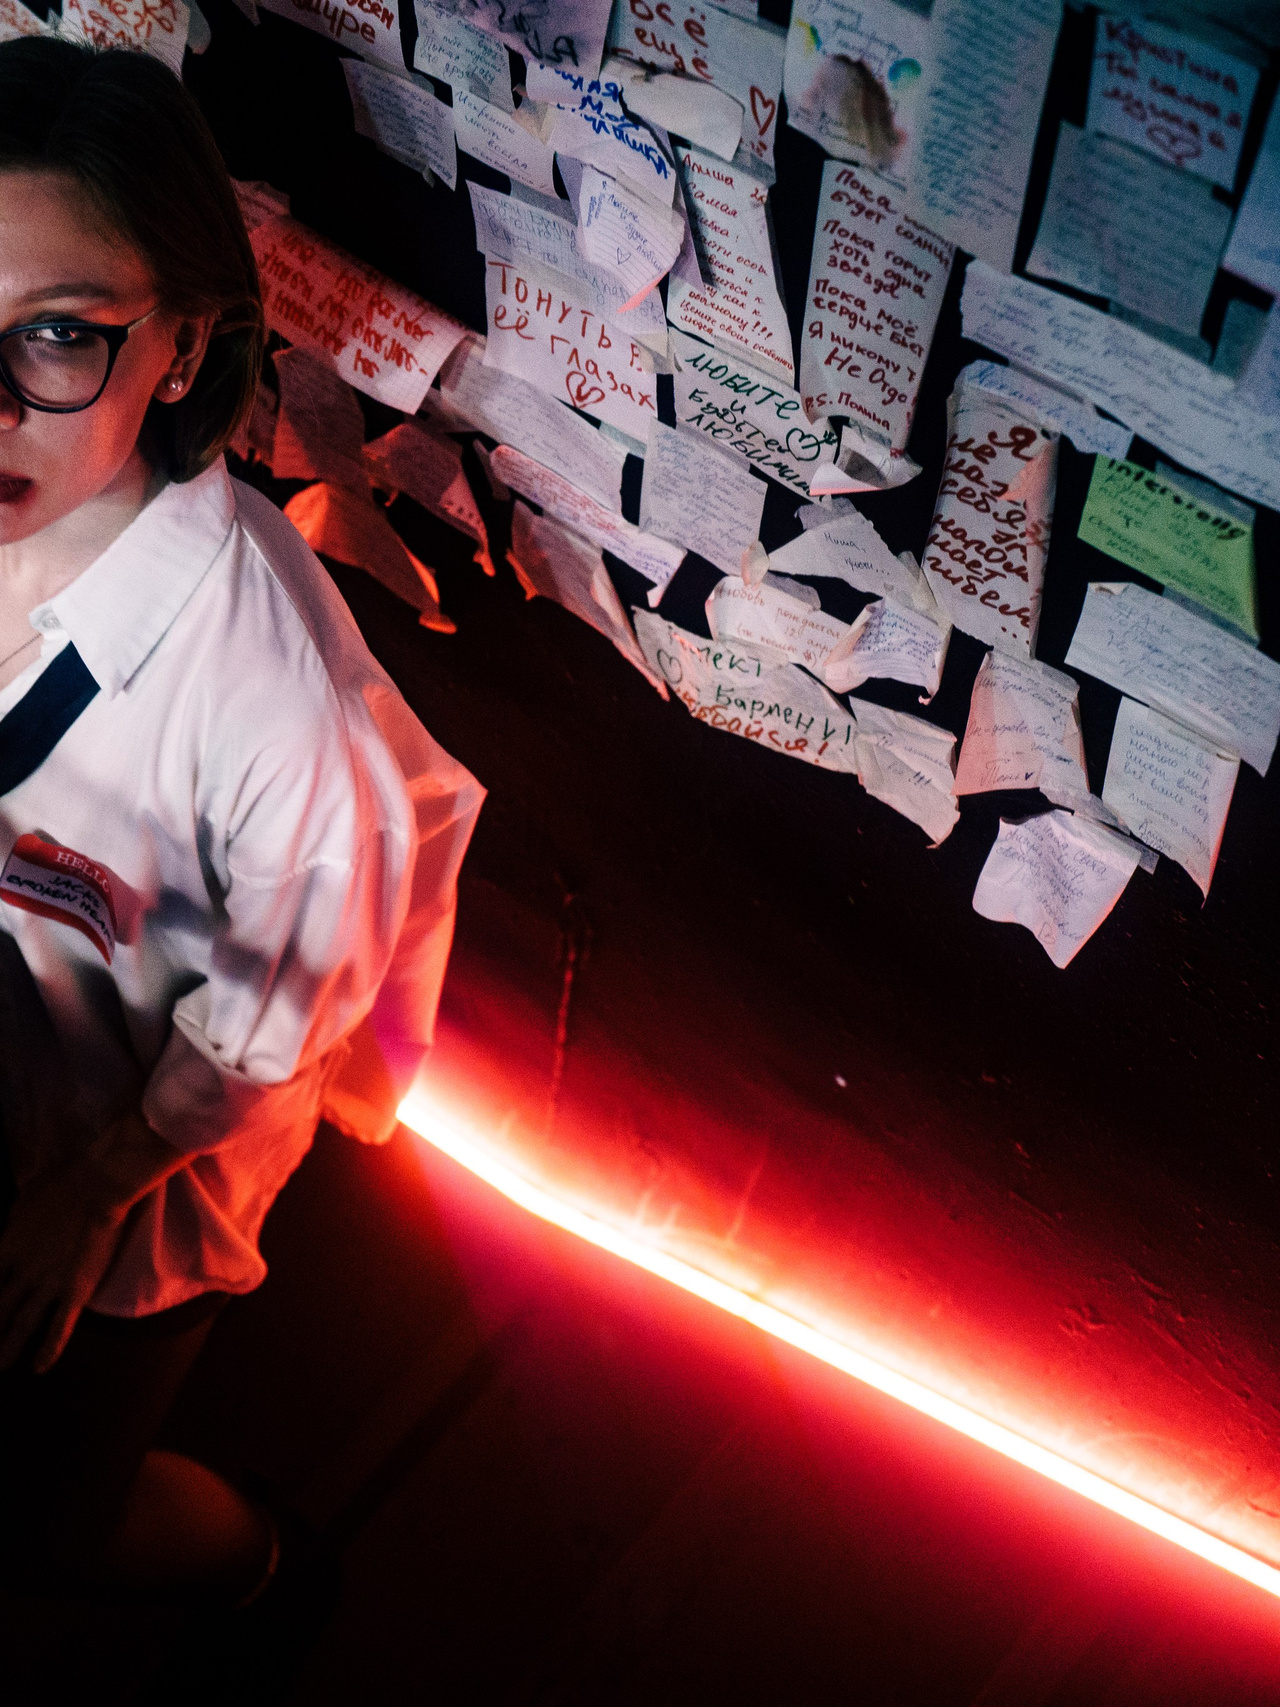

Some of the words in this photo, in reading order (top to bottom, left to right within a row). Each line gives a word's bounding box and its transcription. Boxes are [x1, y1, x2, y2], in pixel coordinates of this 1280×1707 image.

[823, 219, 875, 252] Пока
[486, 260, 613, 350] ТОНУТЬ
[815, 278, 867, 312] Пока
[987, 425, 1038, 462] Я
